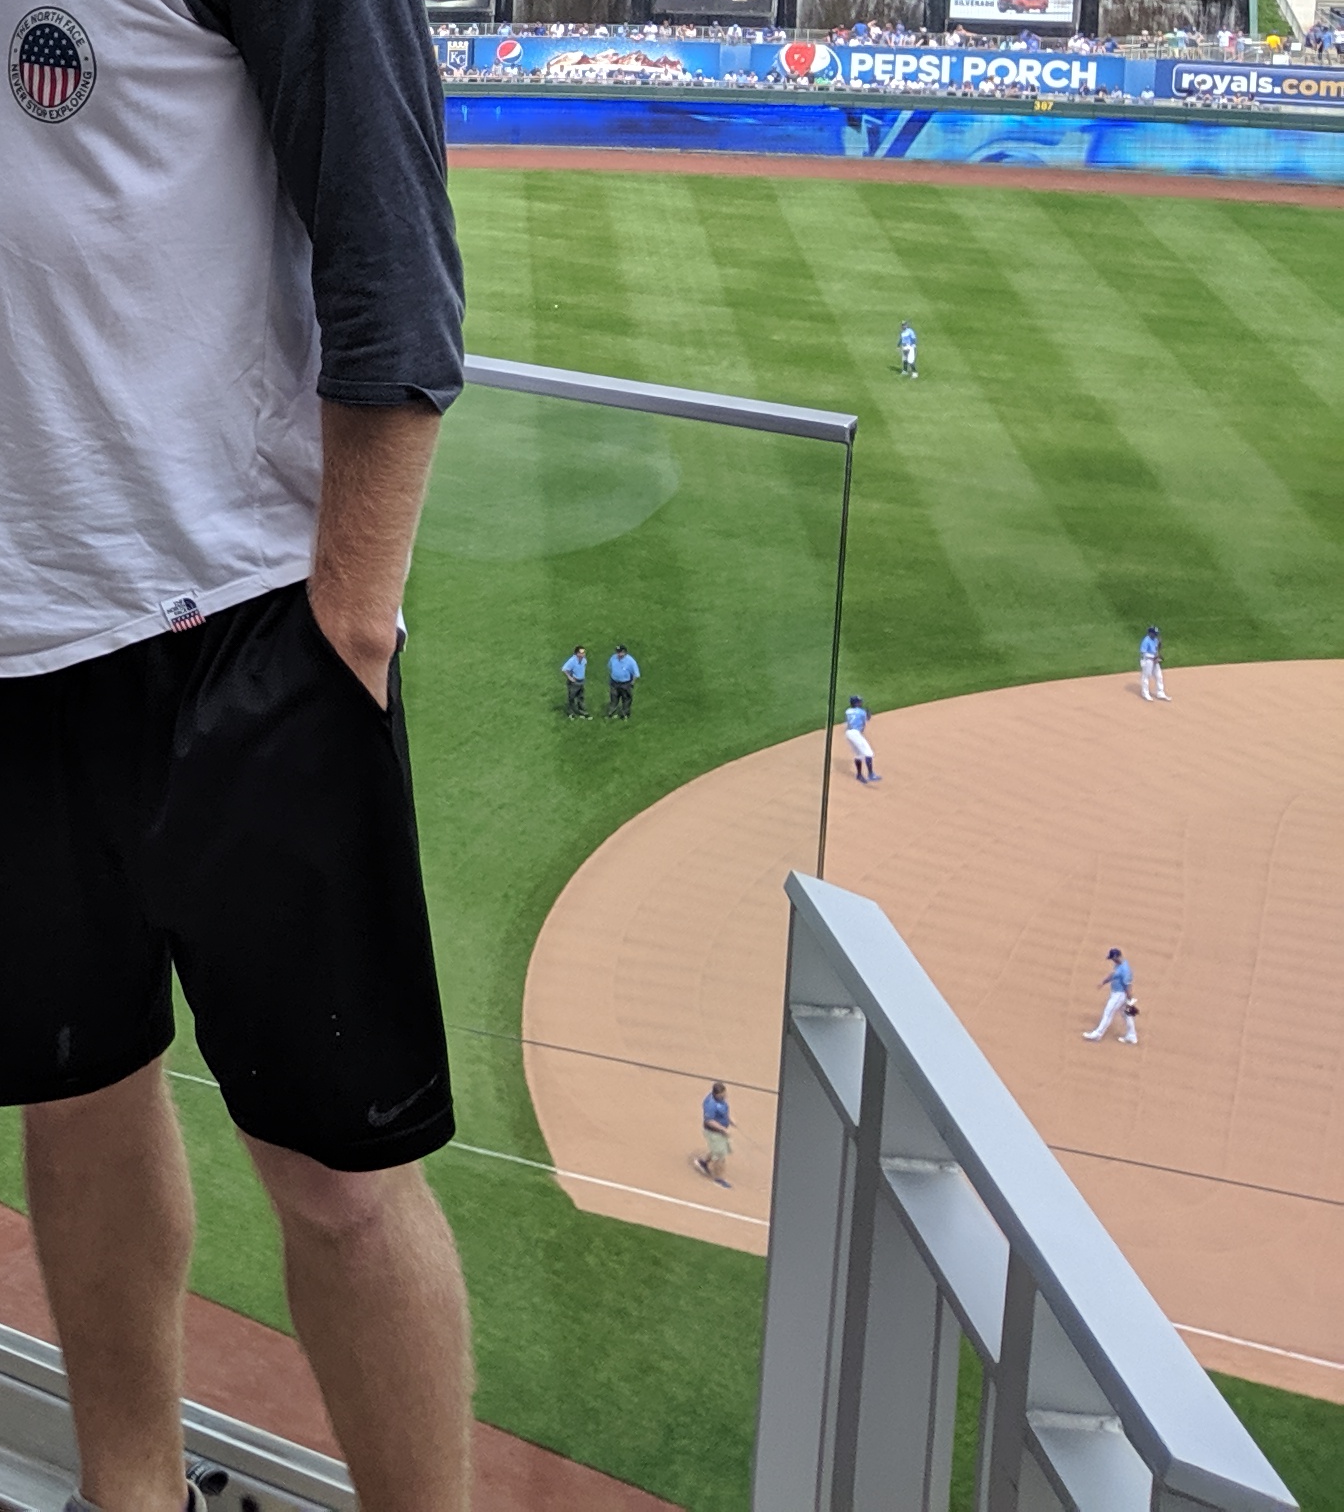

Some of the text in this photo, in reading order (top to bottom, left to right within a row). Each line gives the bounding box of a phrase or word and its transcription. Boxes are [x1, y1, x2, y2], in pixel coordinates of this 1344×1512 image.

[15, 10, 86, 48] THE NORTH FACE
[850, 52, 1097, 90] PEPSI PORCH
[1181, 70, 1344, 98] royals.com
[11, 63, 93, 120] NEVER STOP EXPLORING
